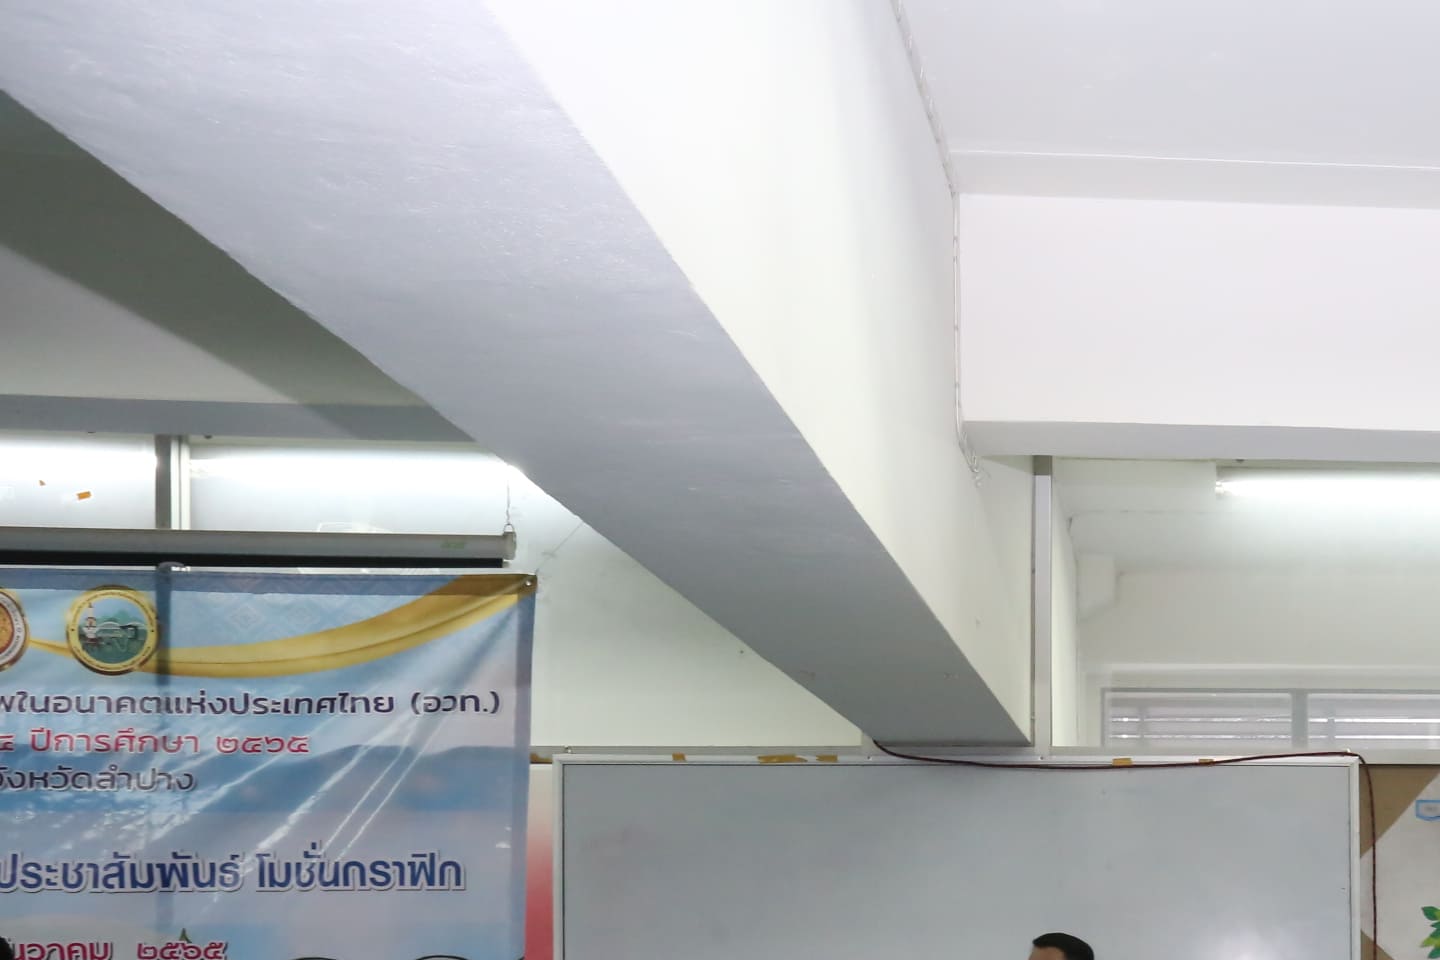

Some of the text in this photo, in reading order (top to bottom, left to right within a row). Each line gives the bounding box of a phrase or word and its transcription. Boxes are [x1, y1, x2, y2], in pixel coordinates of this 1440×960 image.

[411, 690, 500, 715] (อวท.)
[30, 727, 199, 752] ปีการศึกษา
[216, 735, 309, 754] ๒๕๖๕
[0, 841, 463, 889] ประชาสัมพันธ์ โมชั่นกราฟิก
